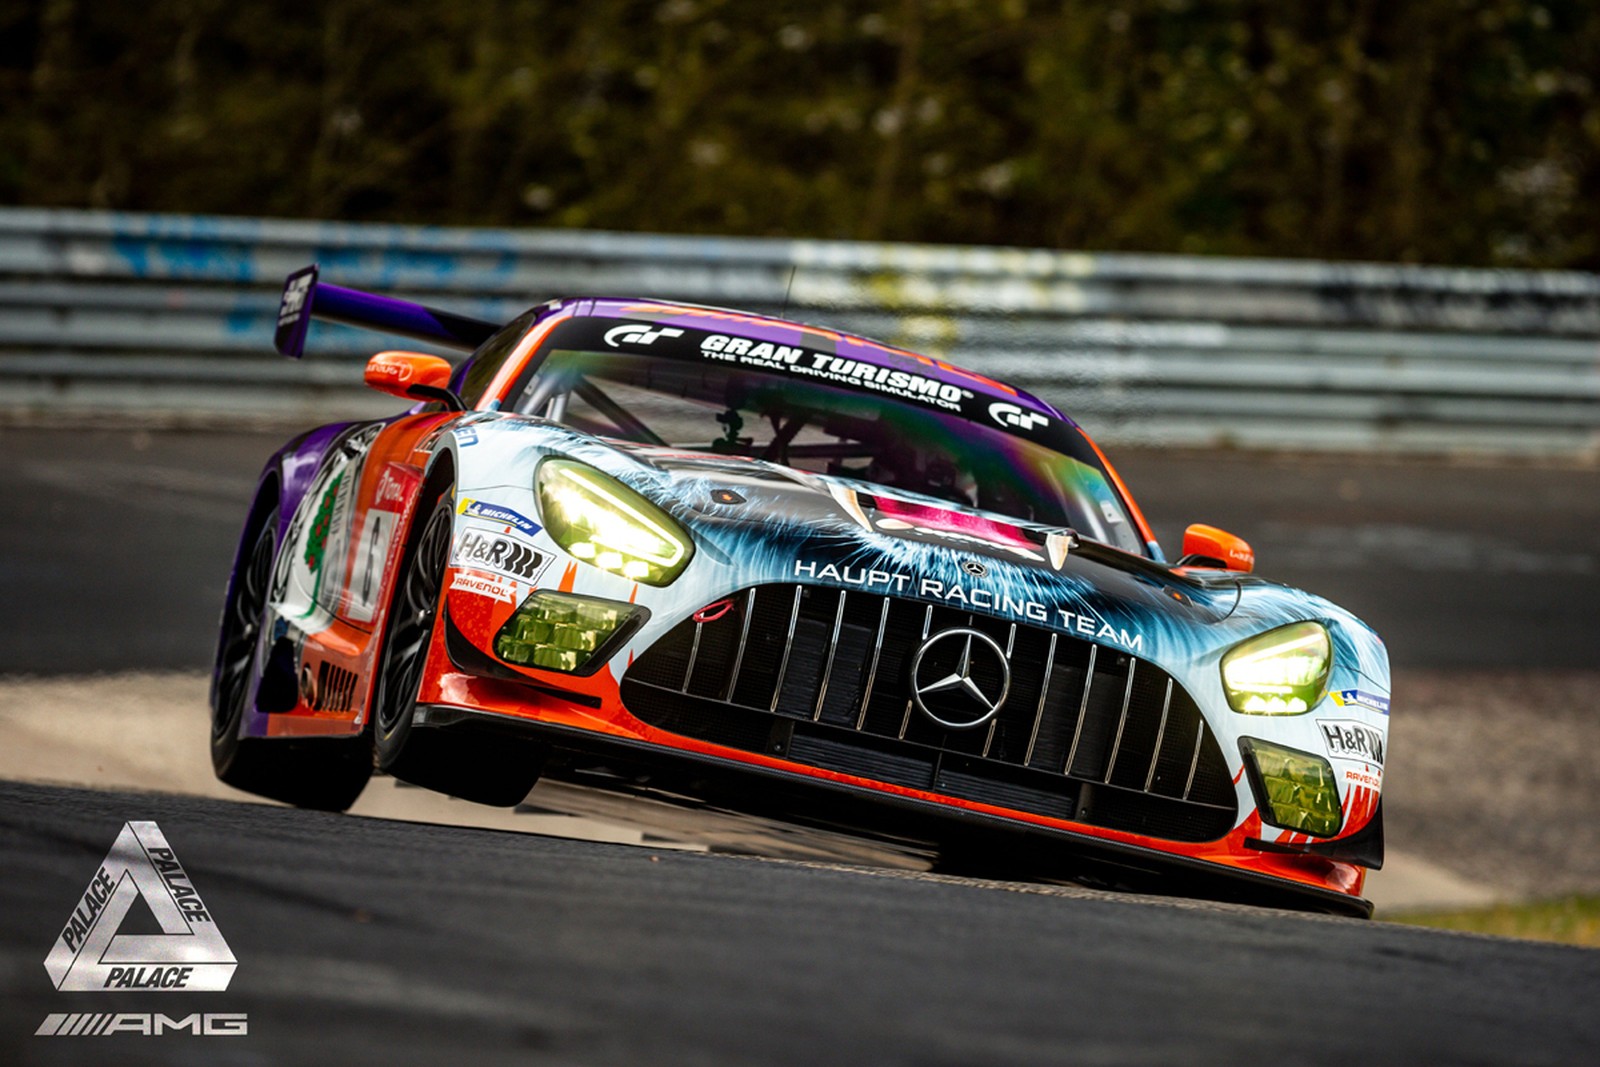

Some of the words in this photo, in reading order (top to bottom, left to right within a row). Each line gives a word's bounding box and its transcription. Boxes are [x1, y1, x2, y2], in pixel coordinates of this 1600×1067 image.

[700, 335, 804, 365] GRAN
[701, 350, 736, 362] THE
[740, 355, 785, 371] REAL
[789, 363, 861, 386] DRIVING
[863, 378, 962, 412] SIMULATOR
[481, 507, 533, 530] MICHELIN
[458, 533, 508, 566] H&R
[454, 576, 509, 598] RAVENOL
[794, 560, 911, 592] HAUPT
[921, 580, 1048, 622] RACING
[1058, 609, 1144, 651] TEAM
[1322, 724, 1369, 754] H&R
